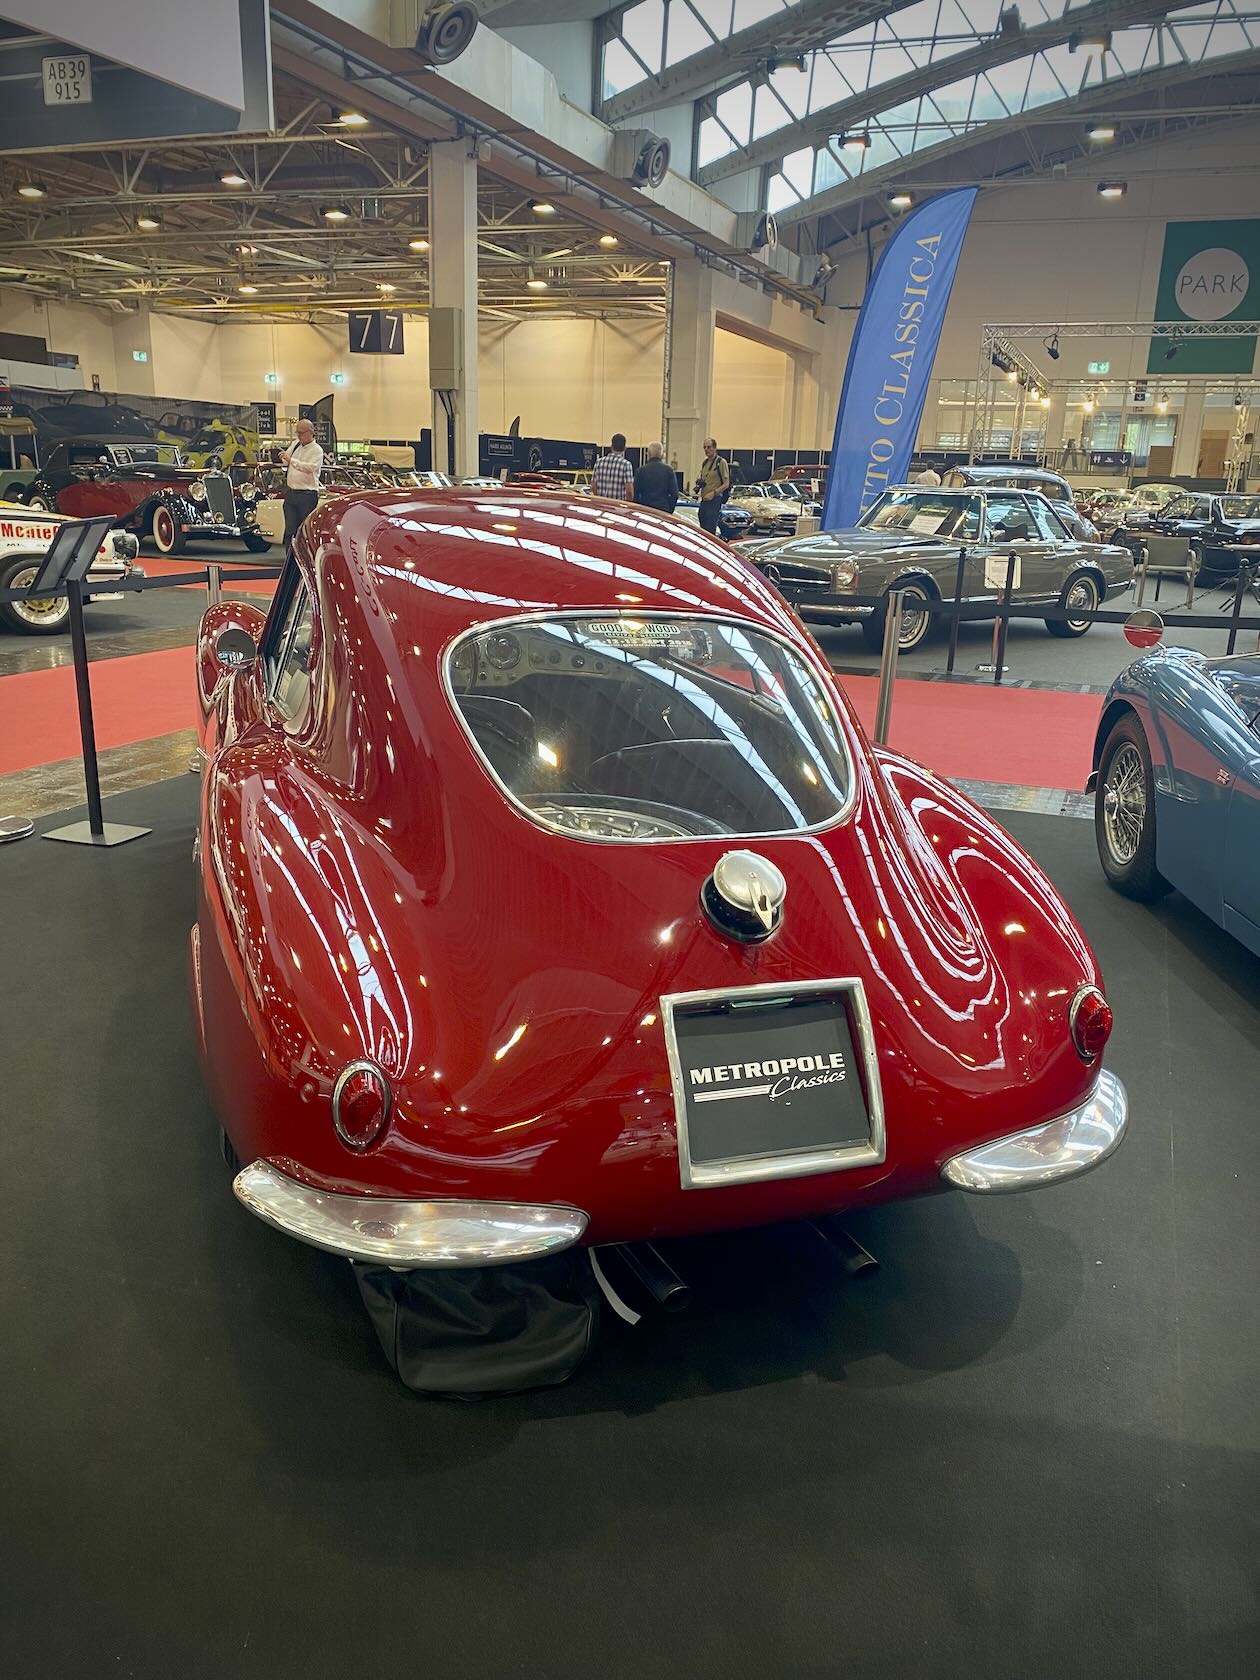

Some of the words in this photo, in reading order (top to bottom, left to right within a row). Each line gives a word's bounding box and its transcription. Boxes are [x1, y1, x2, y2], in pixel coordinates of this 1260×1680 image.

[49, 60, 85, 80] AB39
[55, 81, 81, 99] 915
[1180, 274, 1245, 294] PARK
[355, 314, 372, 349] 7
[385, 315, 398, 349] 7
[873, 231, 943, 426] CLASSICA
[591, 623, 623, 633] GOOD
[644, 623, 678, 633] WOOD
[690, 1053, 845, 1085] METROPOLE
[769, 1070, 846, 1101] Classics
